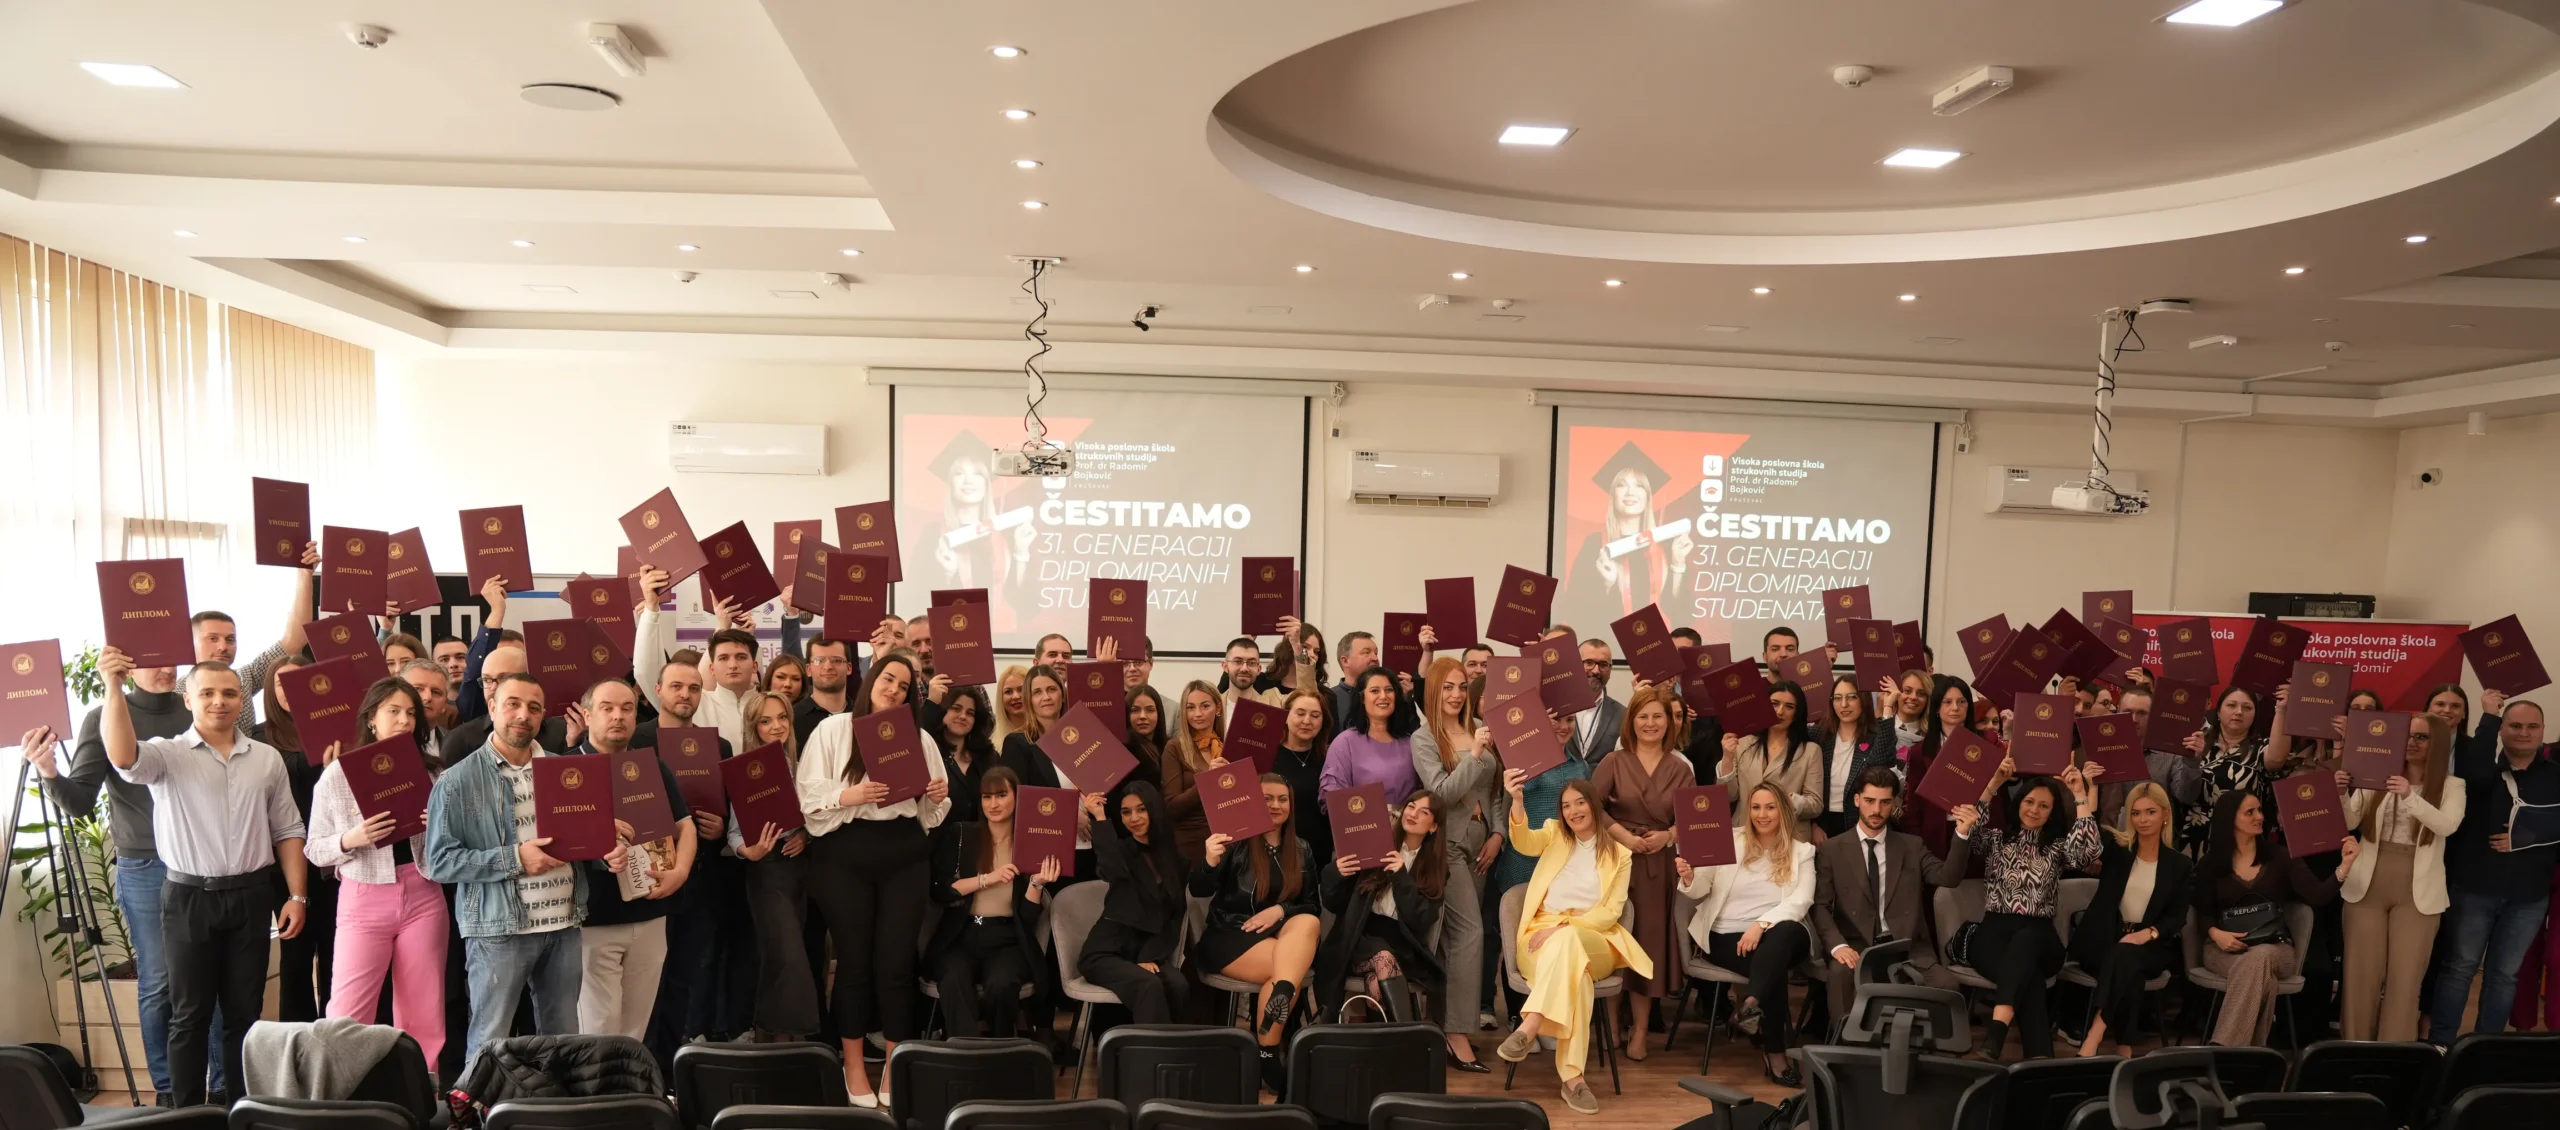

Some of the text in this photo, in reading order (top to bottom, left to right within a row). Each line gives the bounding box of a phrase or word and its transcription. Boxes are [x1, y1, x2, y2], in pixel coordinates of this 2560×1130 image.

[1074, 442, 1176, 453] Visoka poslovna škola
[1075, 452, 1157, 463] strukovnih studija
[1732, 457, 1825, 469] Visoka poslovna škola
[1097, 462, 1107, 470] dr
[1109, 462, 1148, 471] Radomir
[1074, 471, 1112, 481] Bojković
[1731, 467, 1807, 479] strukovnih studija
[1730, 476, 1798, 486] Prof. dr Radomir
[1730, 485, 1765, 495] Bojković
[1039, 492, 1251, 530] ČESTITAMO
[1696, 505, 1891, 544] ČESTITAMO
[648, 530, 678, 553] ДИПЛОМА
[852, 540, 884, 550] ДИПЛОМА
[1037, 532, 1232, 557] 31. GENERACIJI
[478, 546, 514, 556] ДИПЛОМА
[1692, 544, 1873, 571] 31. GENERACIJI
[336, 566, 373, 576] ДИПЛОМА
[720, 561, 751, 581] ДИПЛОМА
[805, 571, 825, 582] ДИПЛО
[1039, 560, 1230, 584] DIPLOMIRANIH
[838, 594, 873, 602] ДИПЛОМА
[1038, 587, 1197, 610] STUATA!
[1253, 592, 1283, 600] ДИПЛОМА
[1506, 601, 1536, 615] ДИПЛОМА
[121, 609, 170, 620] ДИПЛОМА
[593, 616, 621, 625] ПЛОМА
[1100, 615, 1133, 623] ДИПЛОМА
[2210, 628, 2235, 640] kola
[2334, 633, 2397, 647] poslovna
[2400, 634, 2436, 647] škola
[945, 640, 978, 651] ДИПЛОМА
[1636, 640, 1662, 656] ДИПЛОМА
[2172, 649, 2203, 659] ДИПЛОМА
[2253, 651, 2285, 666] ДИПЛОМА
[2302, 647, 2407, 662] ukovnih studija
[2487, 651, 2521, 667] ДИПЛОМА
[542, 663, 577, 673] ДИПЛОМА
[2012, 659, 2038, 681] ДИПЛОМА
[1542, 671, 1573, 685] ДИПЛОМА
[6, 687, 48, 700] ДИПЛОМА
[2301, 696, 2334, 705] ДИПЛОМА
[309, 703, 350, 720] ДИПЛОМА
[2160, 712, 2191, 722] ДИПЛОМА
[1509, 728, 1540, 748] ДИПЛОМА
[2025, 730, 2059, 739] ДИПЛОМА
[1237, 736, 1267, 749] ДИПЛОМА
[2097, 744, 2129, 752] ДИПЛОМА
[878, 748, 910, 764] ДИПЛОМА
[1074, 740, 1102, 768] ДИПЛОМА
[2356, 745, 2392, 755] ДИПЛОМА
[675, 768, 710, 777] ДИПЛОМА
[1946, 762, 1975, 784] ДИПЛОМА
[373, 780, 415, 801] ДИПЛОМА
[746, 785, 780, 804] ДИПЛОМА
[622, 792, 655, 804] ДИПЛОМА
[1217, 794, 1251, 810] ДИПЛОМА
[552, 804, 596, 814] ДИПЛОМА
[2294, 808, 2329, 821] ДИПЛОМА
[1028, 827, 1063, 836] ДИПЛОМА
[1344, 823, 1378, 834] ДИПЛОМА
[1688, 822, 1720, 831] ДИПЛОМА
[2234, 906, 2258, 916] REPLAY
